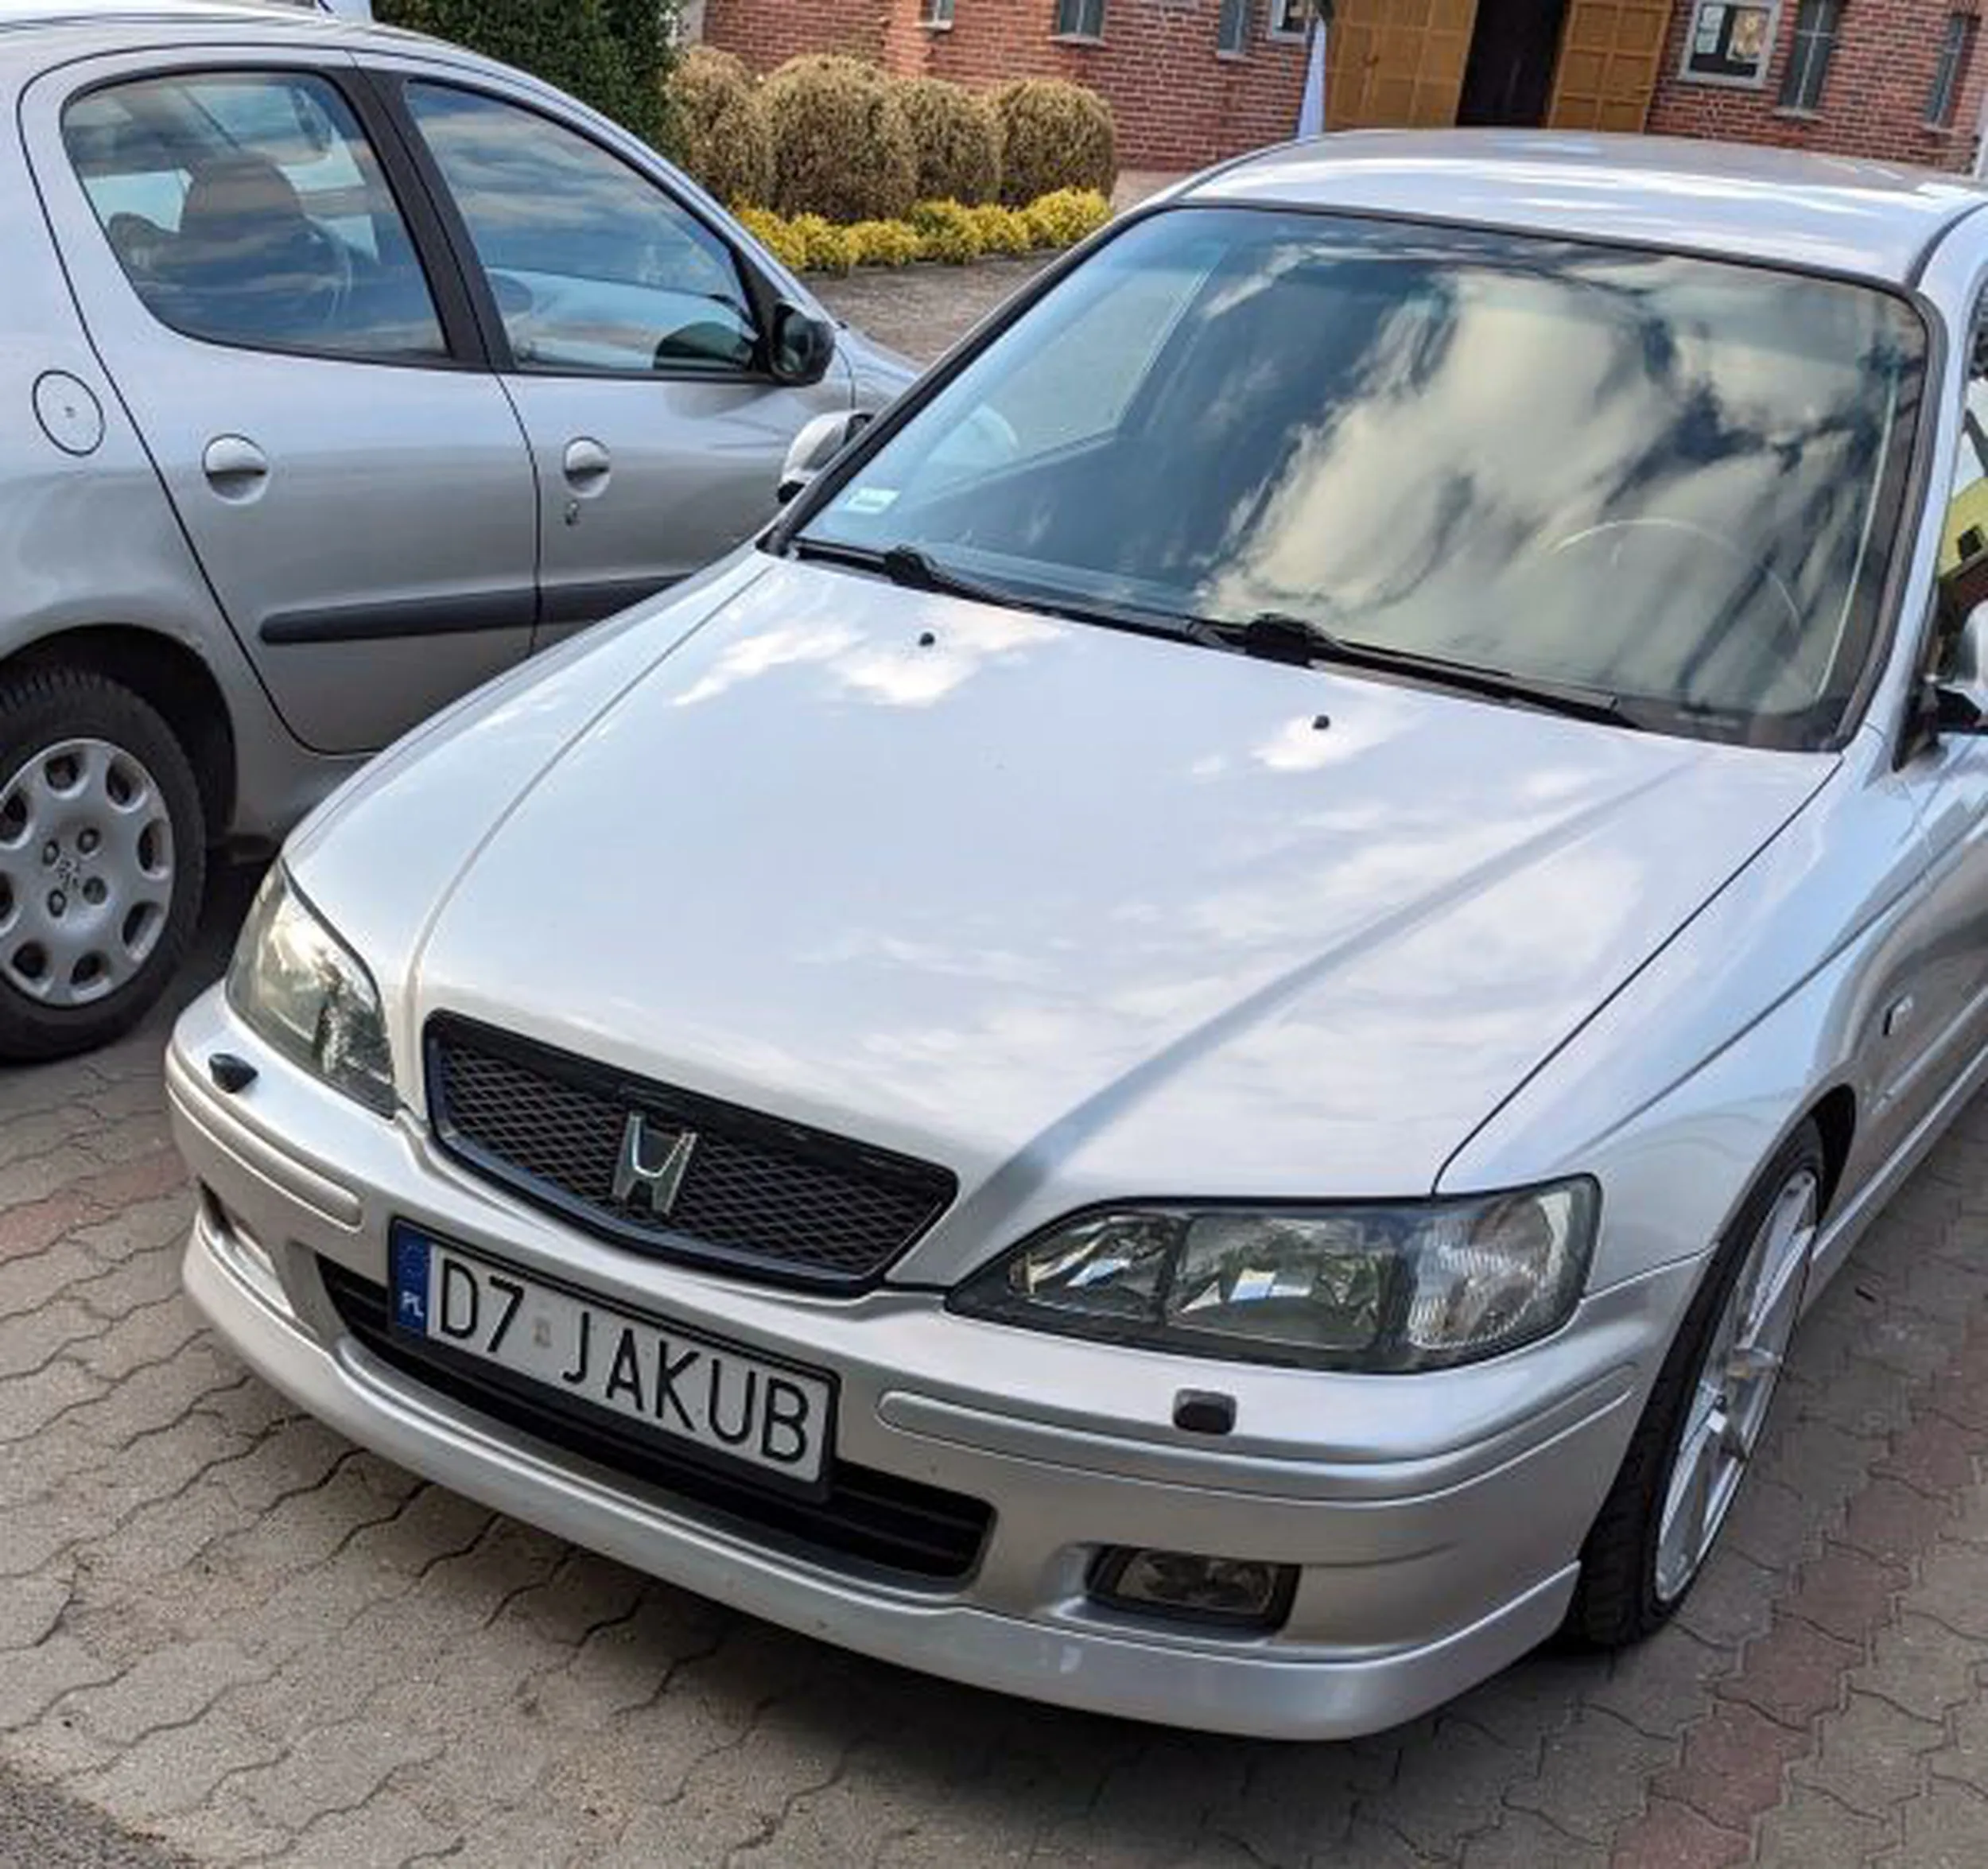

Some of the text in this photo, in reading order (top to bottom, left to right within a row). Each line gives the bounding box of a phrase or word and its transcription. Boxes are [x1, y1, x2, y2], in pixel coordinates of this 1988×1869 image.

[402, 1290, 425, 1318] PL
[440, 1258, 809, 1463] D7 JAKUB
